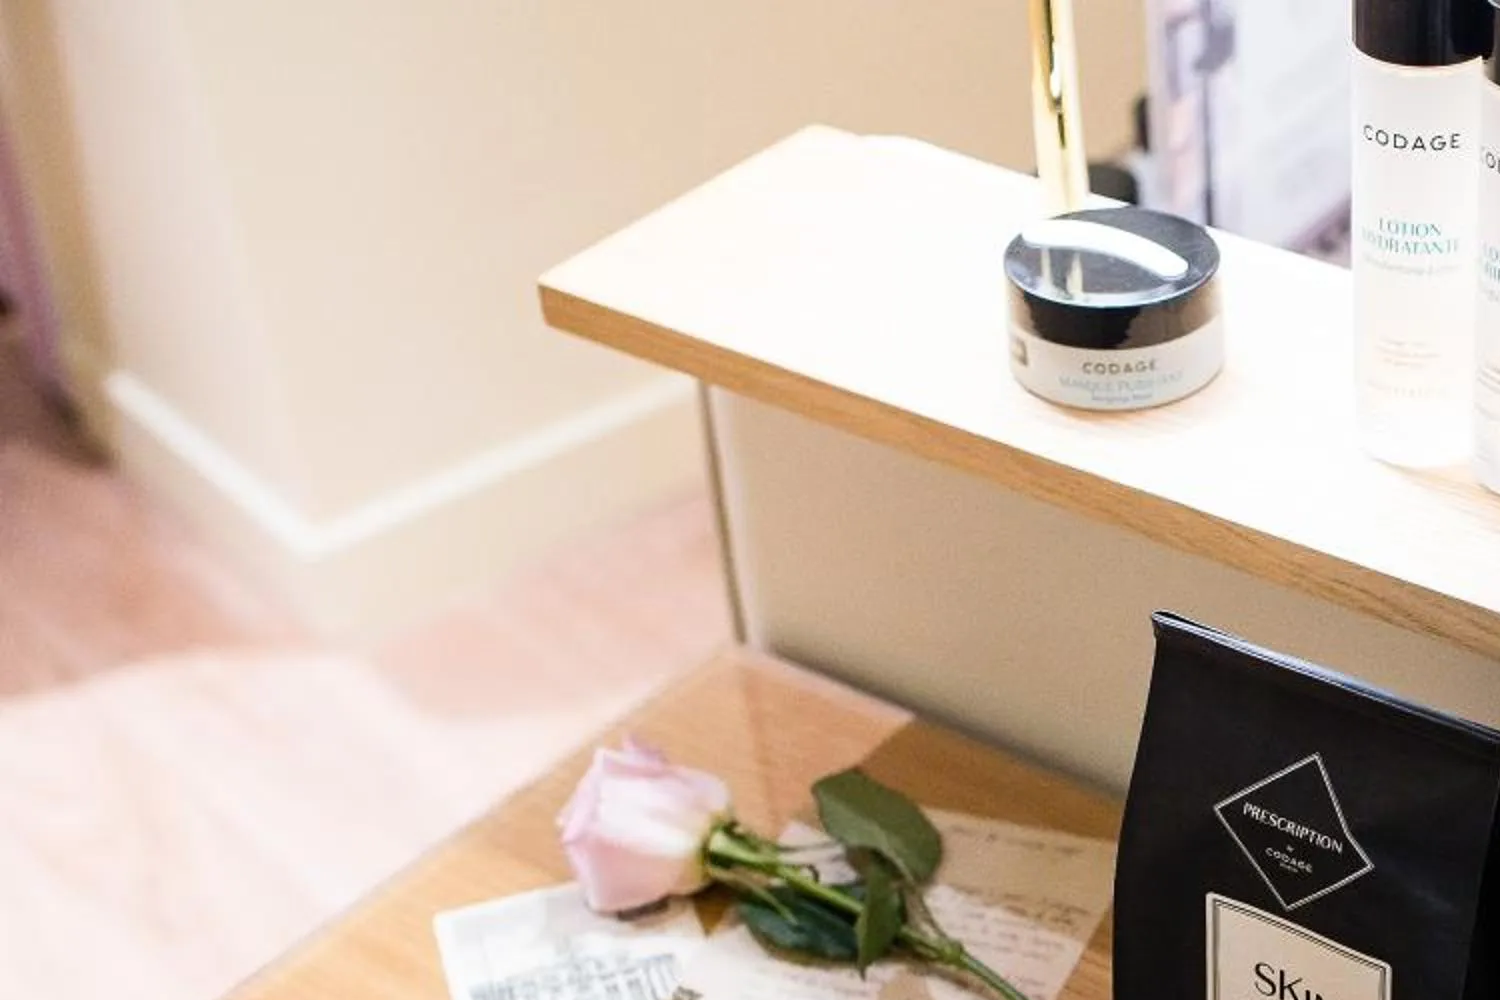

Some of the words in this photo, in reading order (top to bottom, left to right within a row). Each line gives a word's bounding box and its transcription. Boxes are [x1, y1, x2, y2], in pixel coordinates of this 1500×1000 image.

[1363, 125, 1461, 151] CODAGE
[1379, 217, 1441, 238] LOTION
[1082, 360, 1155, 375] CODAGE
[1243, 801, 1343, 855] PRESCRIPTION
[1265, 847, 1313, 873] CODAGE
